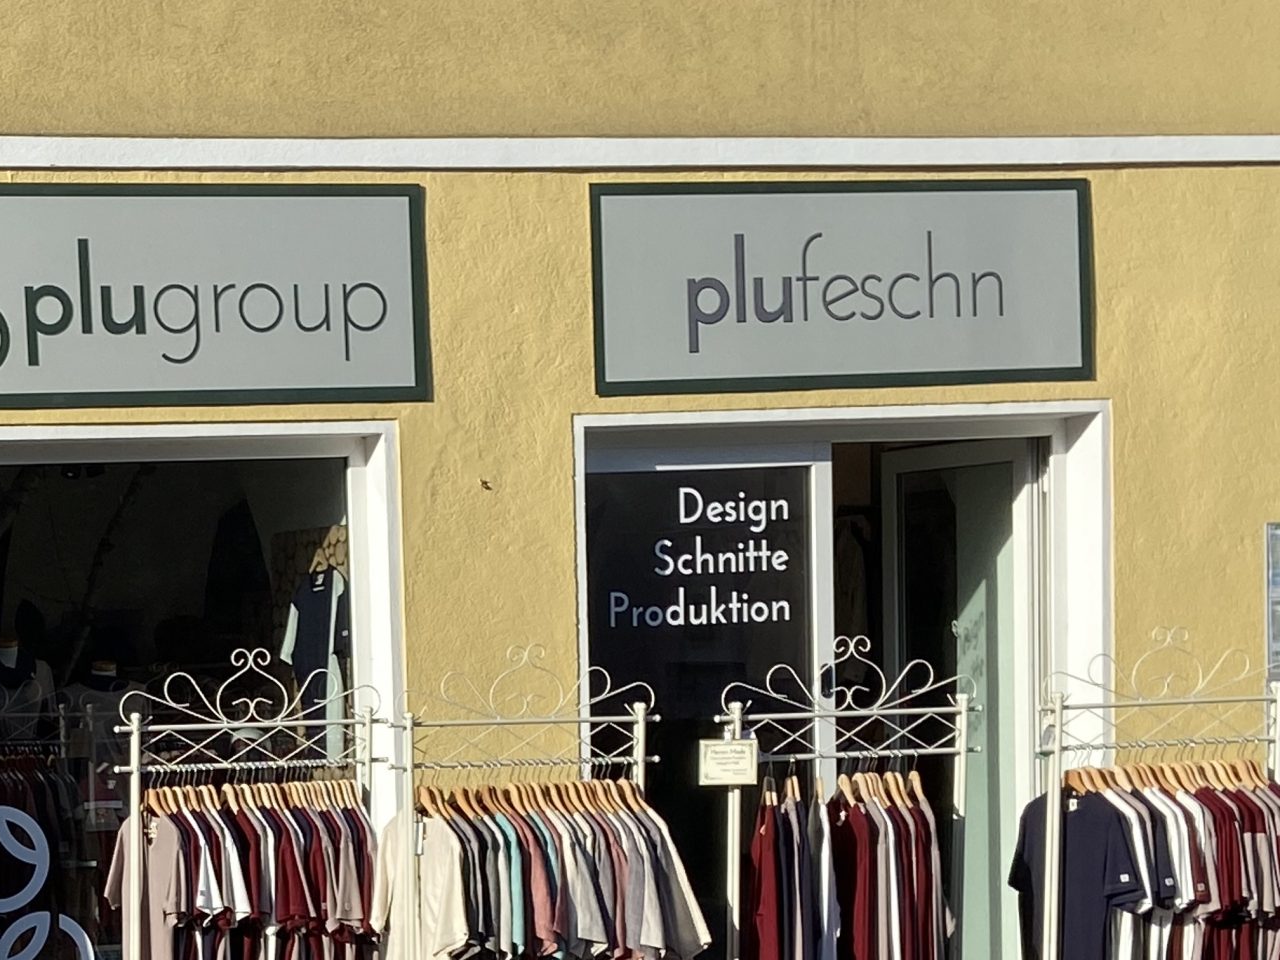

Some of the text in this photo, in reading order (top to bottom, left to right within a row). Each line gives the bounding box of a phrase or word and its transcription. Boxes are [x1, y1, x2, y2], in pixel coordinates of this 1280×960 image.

[24, 238, 388, 367] plugroup
[687, 230, 1005, 354] plufeschn
[678, 486, 789, 533] Design
[654, 535, 790, 576] Schnitte
[609, 585, 791, 628] Produktion
